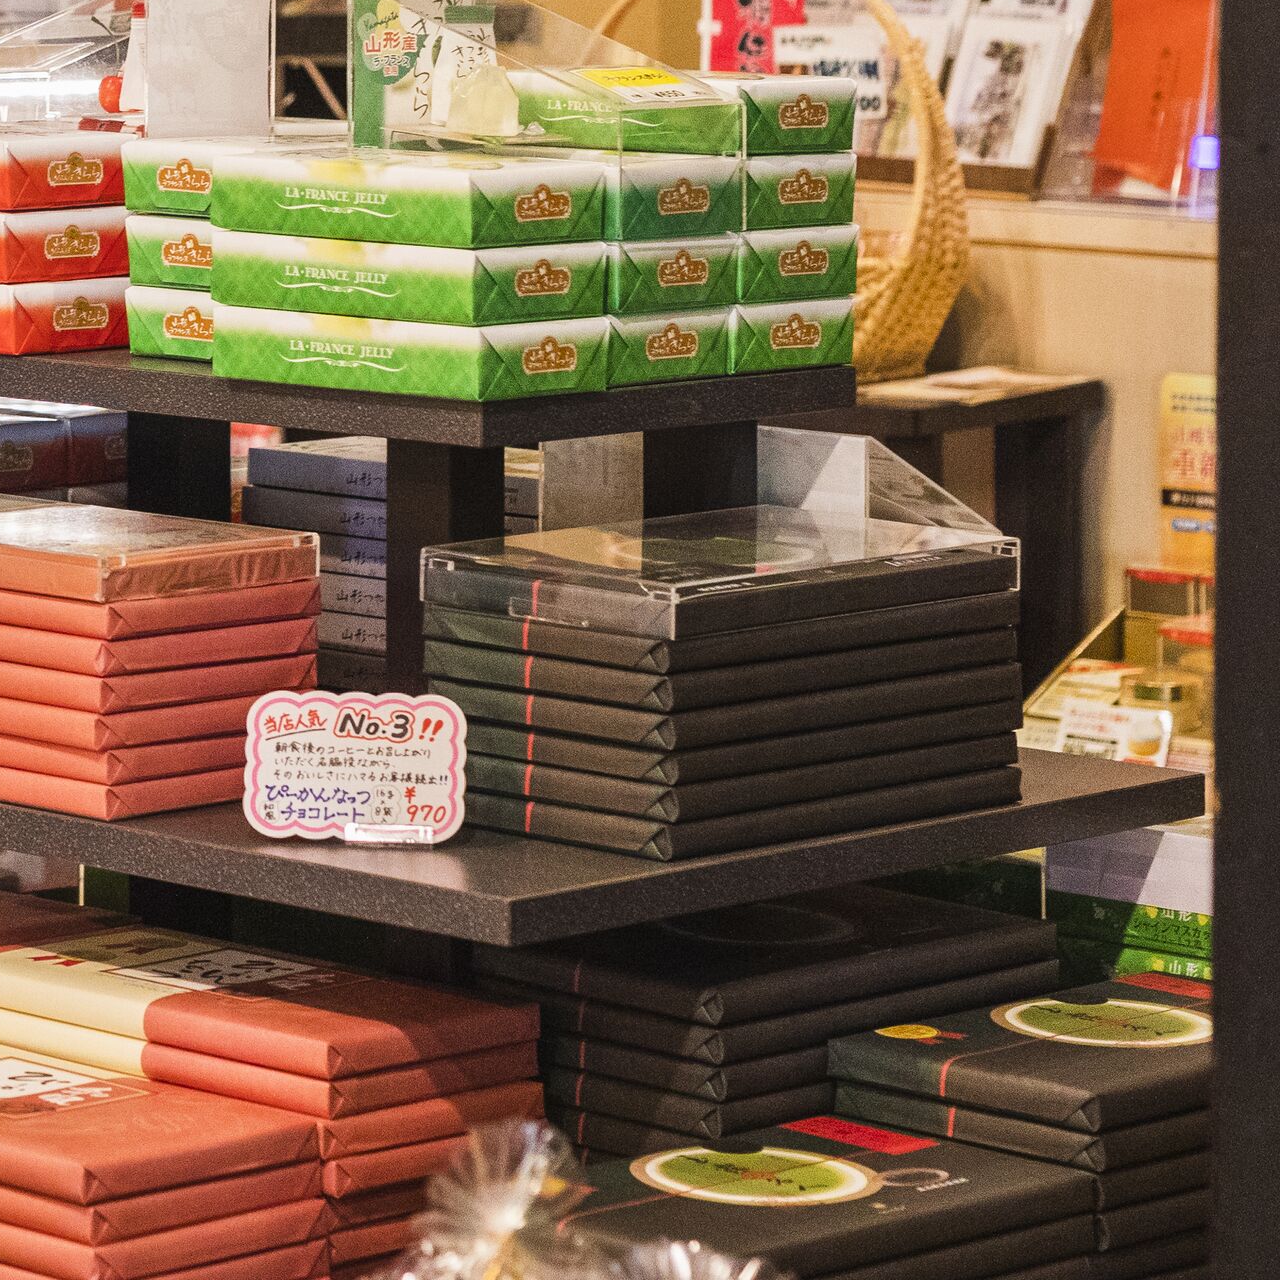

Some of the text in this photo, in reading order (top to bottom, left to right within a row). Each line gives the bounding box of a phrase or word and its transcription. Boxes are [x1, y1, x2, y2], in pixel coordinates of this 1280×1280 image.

[365, 31, 418, 54] 山形産
[354, 191, 389, 205] JELLY
[354, 269, 389, 285] JELLY
[359, 344, 394, 360] JELLY
[264, 708, 328, 734] 当店人気
[338, 711, 411, 739] No.3
[265, 784, 372, 806] ぴーかんなっつ
[280, 802, 366, 823] チョコレート
[406, 805, 447, 824] 970
[1168, 959, 1198, 978] 山形
